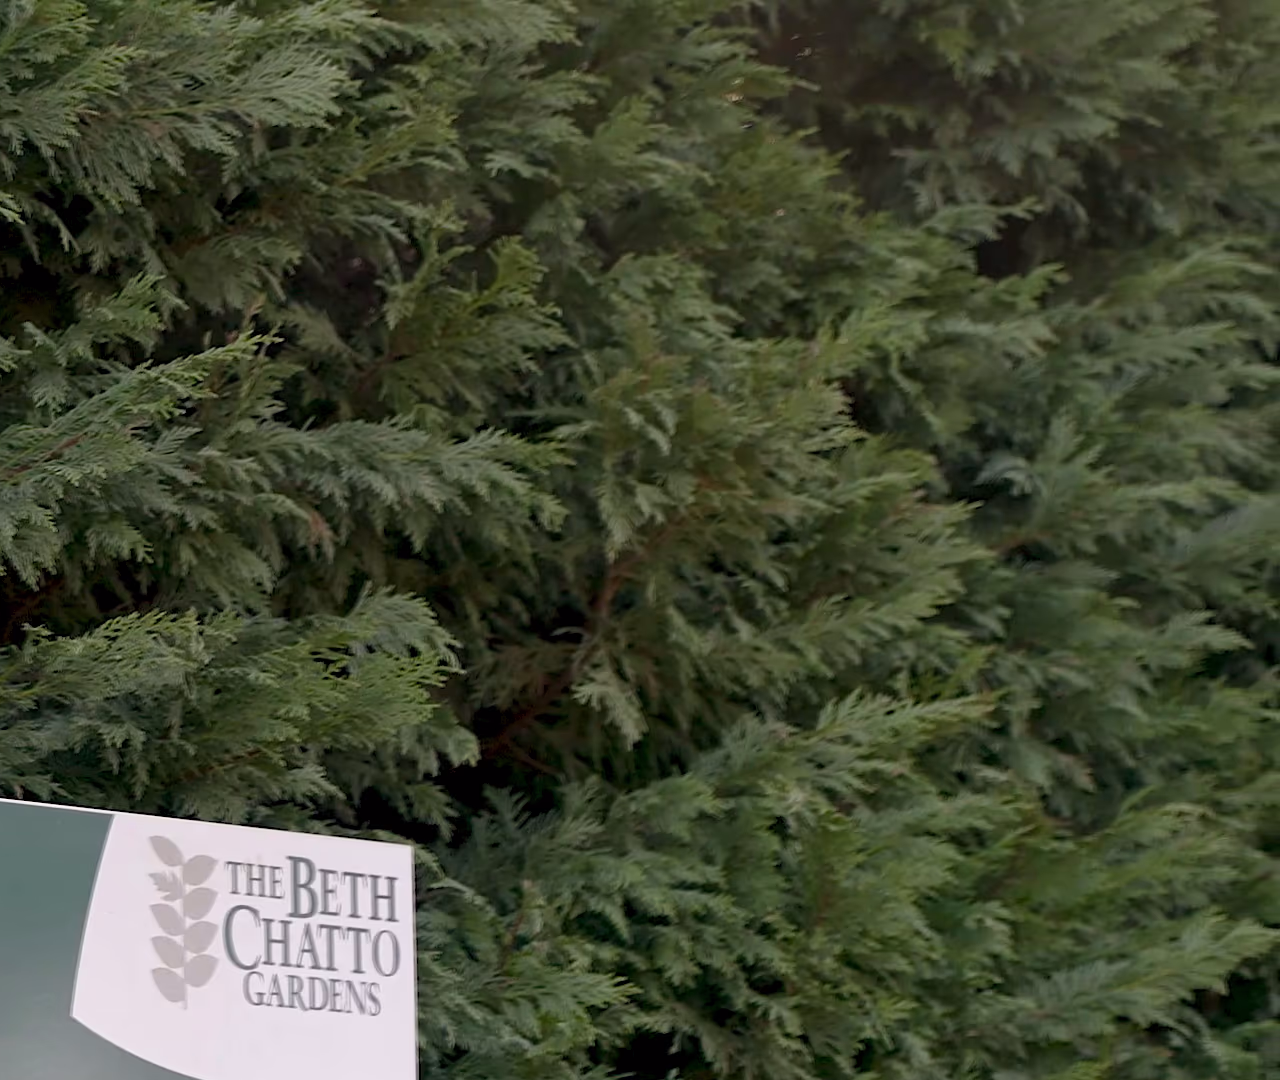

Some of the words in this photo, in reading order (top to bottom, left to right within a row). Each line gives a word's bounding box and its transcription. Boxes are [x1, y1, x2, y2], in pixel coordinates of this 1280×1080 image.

[224, 861, 285, 899] THE
[287, 855, 399, 922] BETH
[222, 905, 401, 977] CHATTO
[242, 971, 382, 1016] GARDENS
